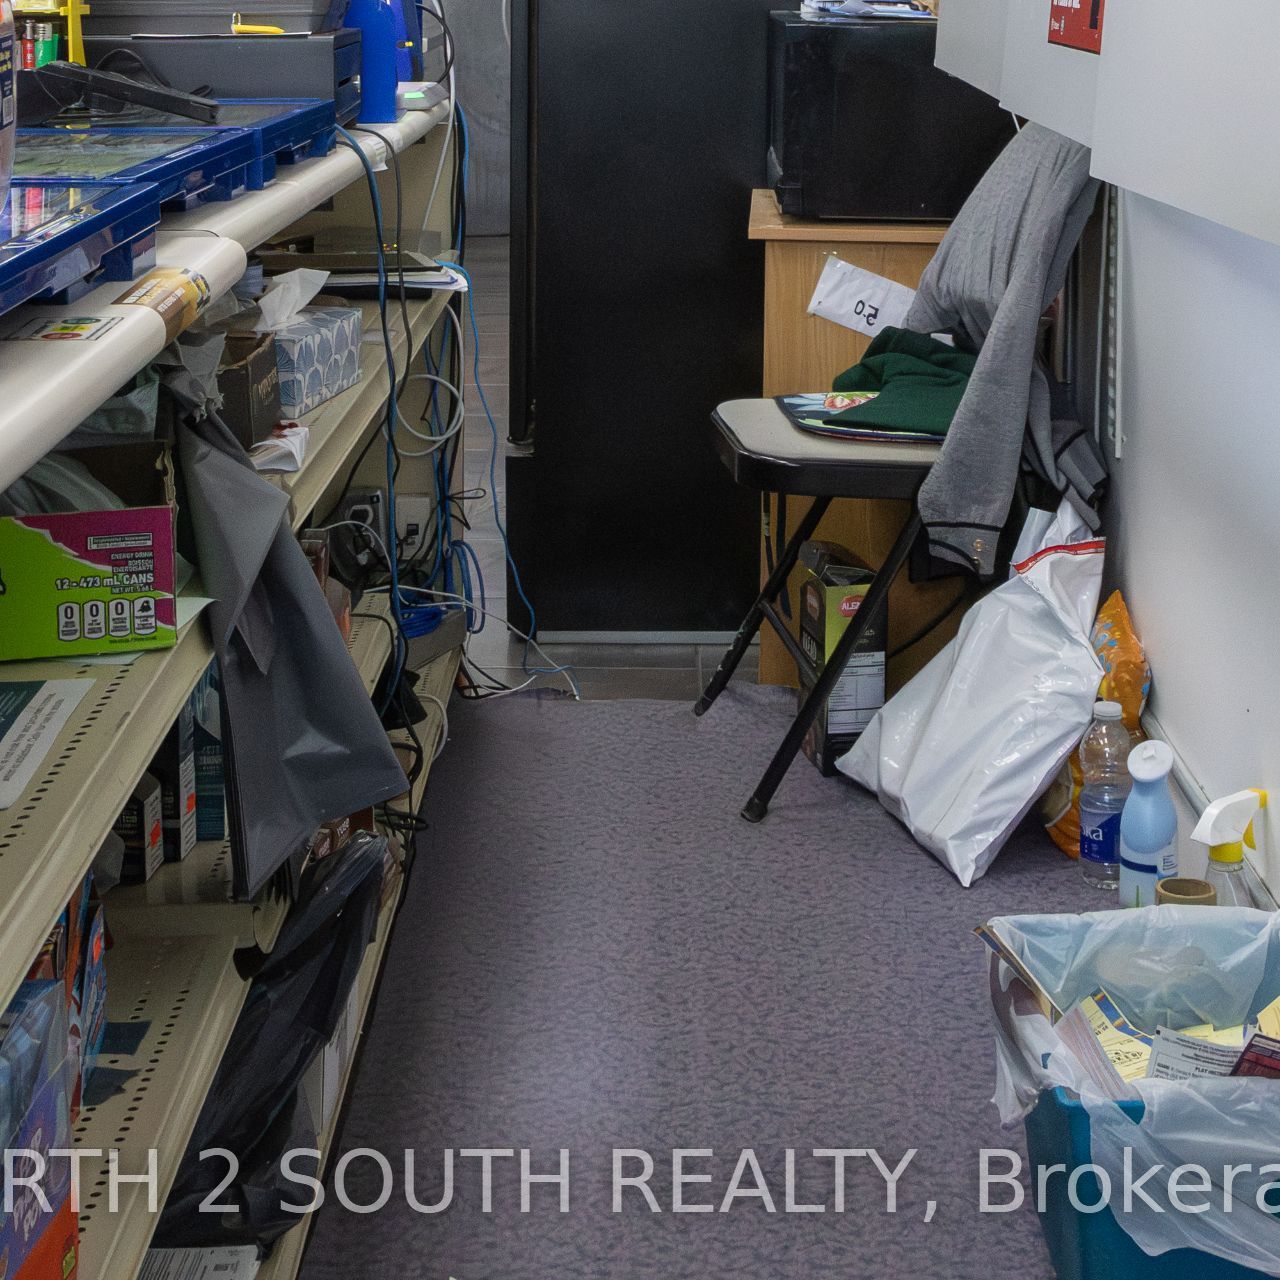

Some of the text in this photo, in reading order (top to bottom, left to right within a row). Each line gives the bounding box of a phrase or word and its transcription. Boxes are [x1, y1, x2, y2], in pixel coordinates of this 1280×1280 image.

[56, 579, 70, 590] 12
[80, 577, 100, 588] 473
[123, 573, 154, 584] CANS
